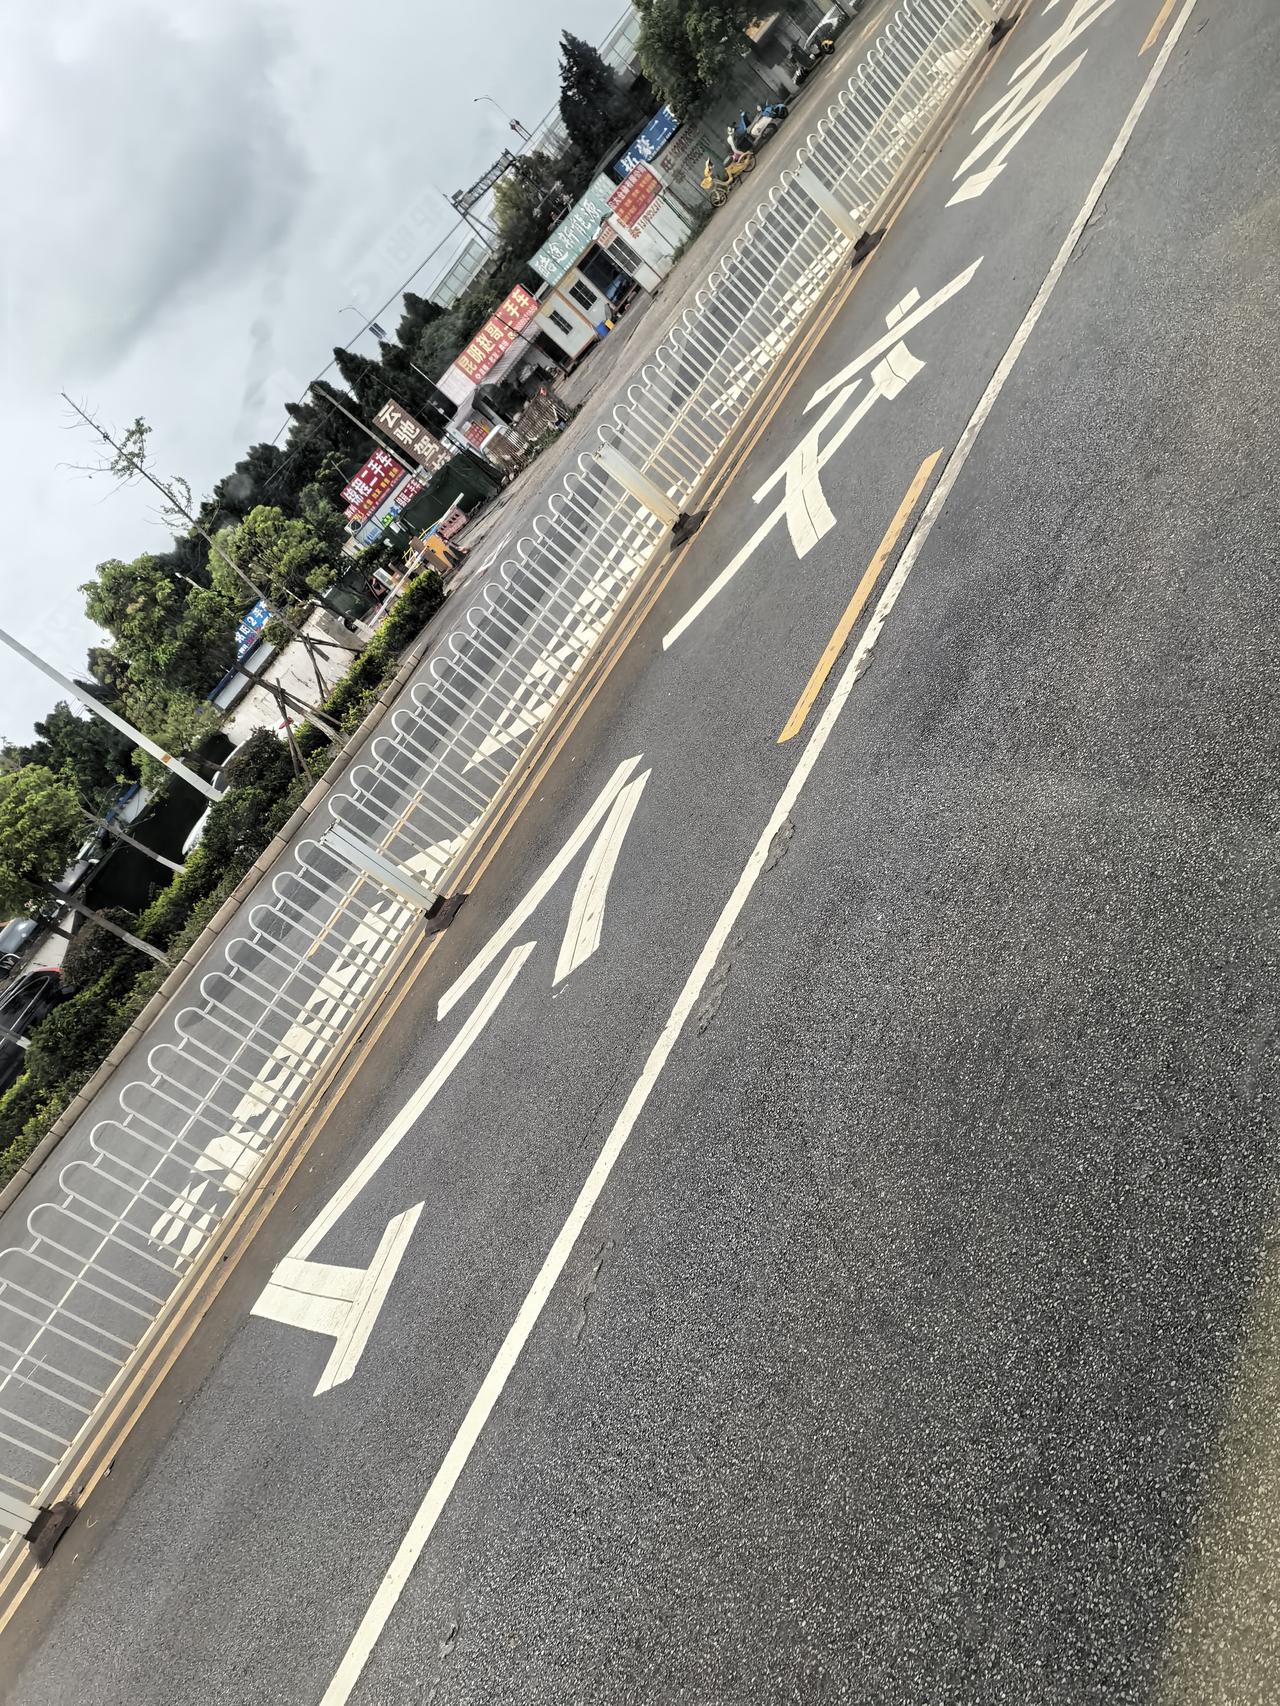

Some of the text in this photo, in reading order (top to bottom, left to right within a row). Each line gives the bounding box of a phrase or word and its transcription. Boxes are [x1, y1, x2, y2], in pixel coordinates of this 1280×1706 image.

[456, 288, 530, 375] 昆明赵哥二手车
